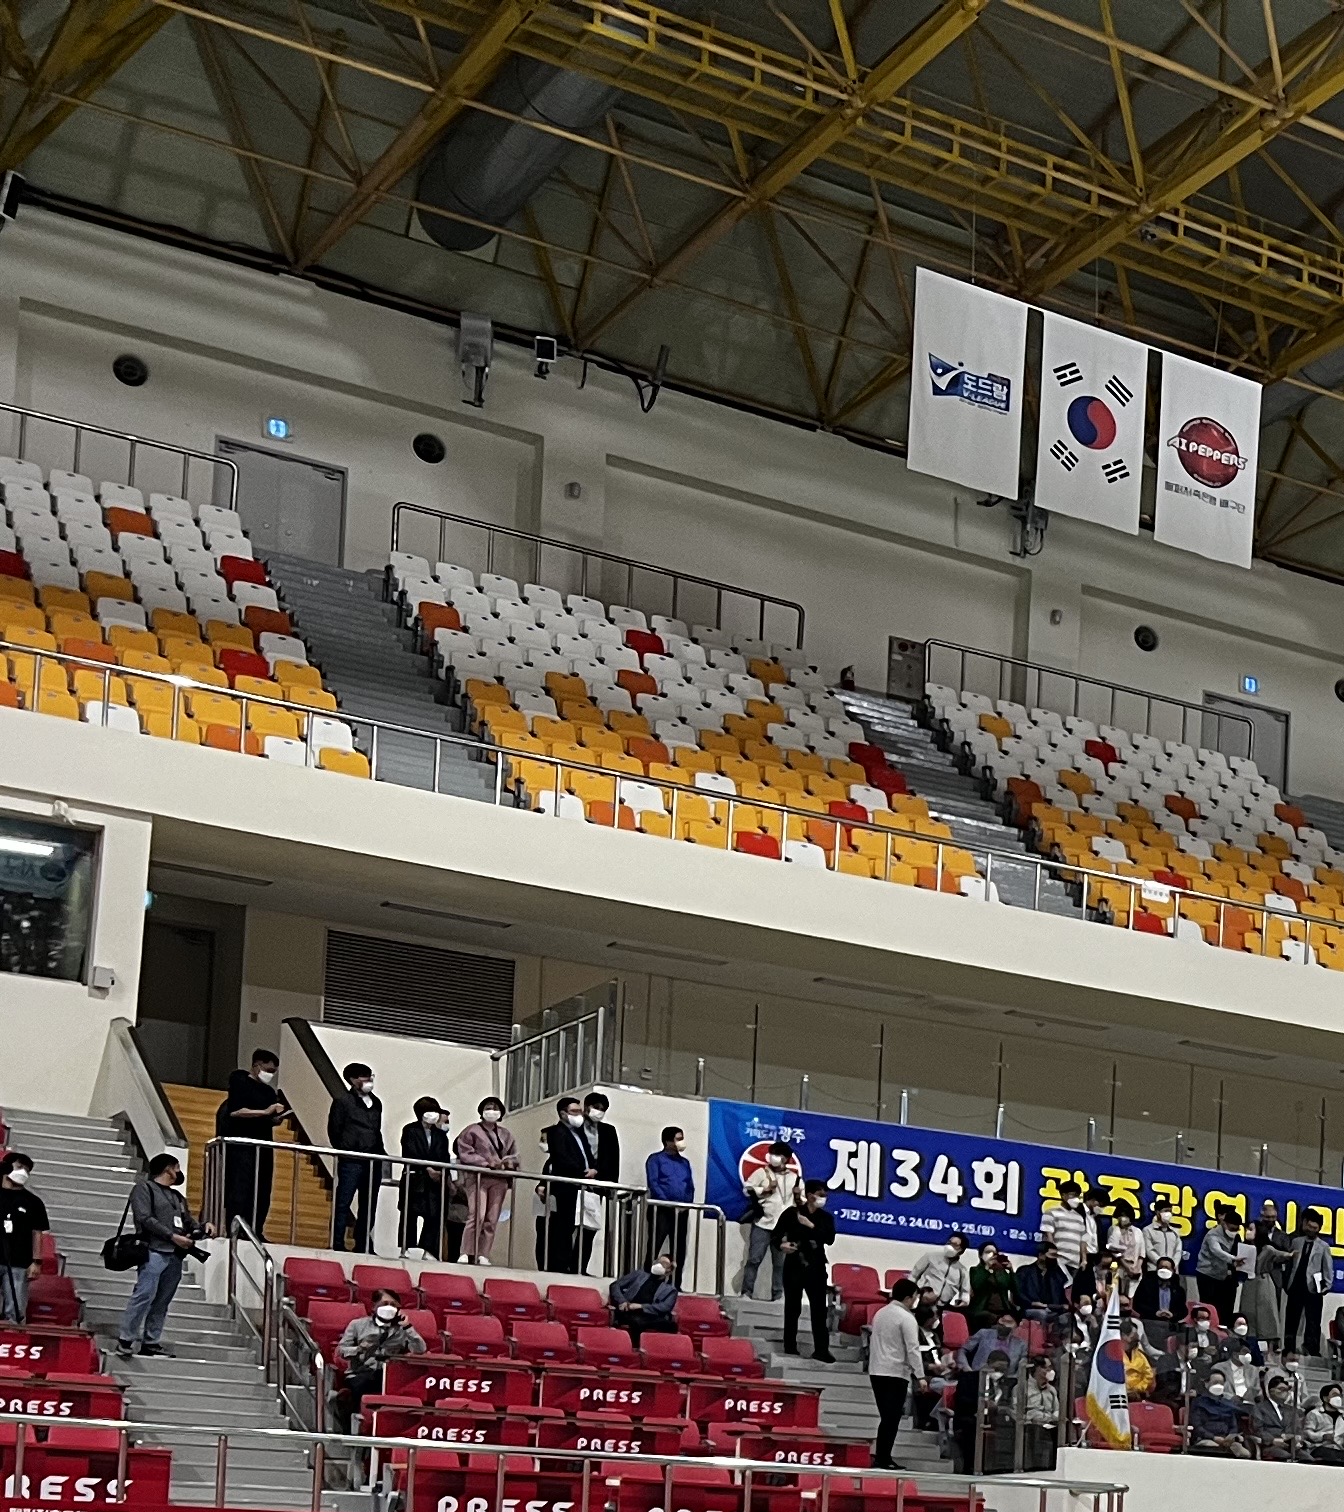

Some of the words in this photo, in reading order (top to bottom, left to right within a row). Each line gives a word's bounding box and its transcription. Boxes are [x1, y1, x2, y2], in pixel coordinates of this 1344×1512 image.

[963, 373, 1008, 401] 도드람
[779, 1126, 806, 1143] 광주
[827, 1138, 1019, 1215] 제34회
[0, 1343, 44, 1360] ESS
[425, 1377, 493, 1393] PRESS
[580, 1388, 643, 1404] PRESS
[725, 1399, 784, 1414] PRESS
[417, 1426, 488, 1443] PRESS
[577, 1437, 642, 1453] PRESS
[775, 1450, 835, 1465] PRESS
[5, 1473, 134, 1504] RESS
